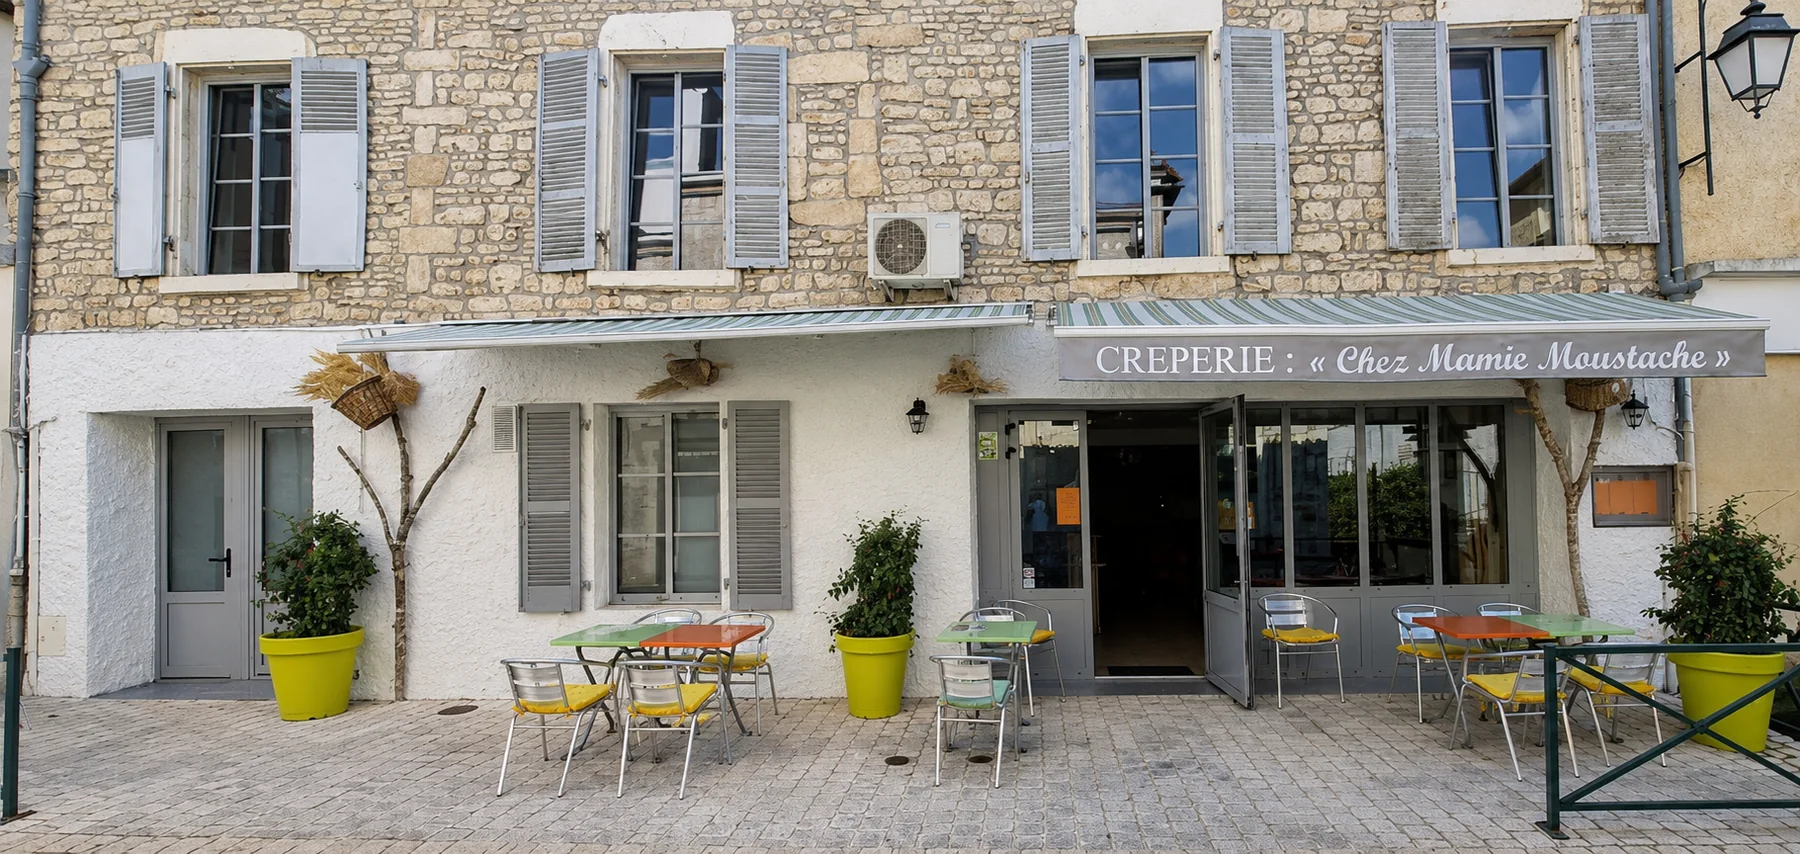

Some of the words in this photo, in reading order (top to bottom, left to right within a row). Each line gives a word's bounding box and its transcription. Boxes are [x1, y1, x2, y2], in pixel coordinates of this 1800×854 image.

[1096, 345, 1276, 374] CREPERIE
[1336, 345, 1410, 374] Chez
[1417, 342, 1529, 374] Mamie
[1537, 339, 1707, 371] Moustache
